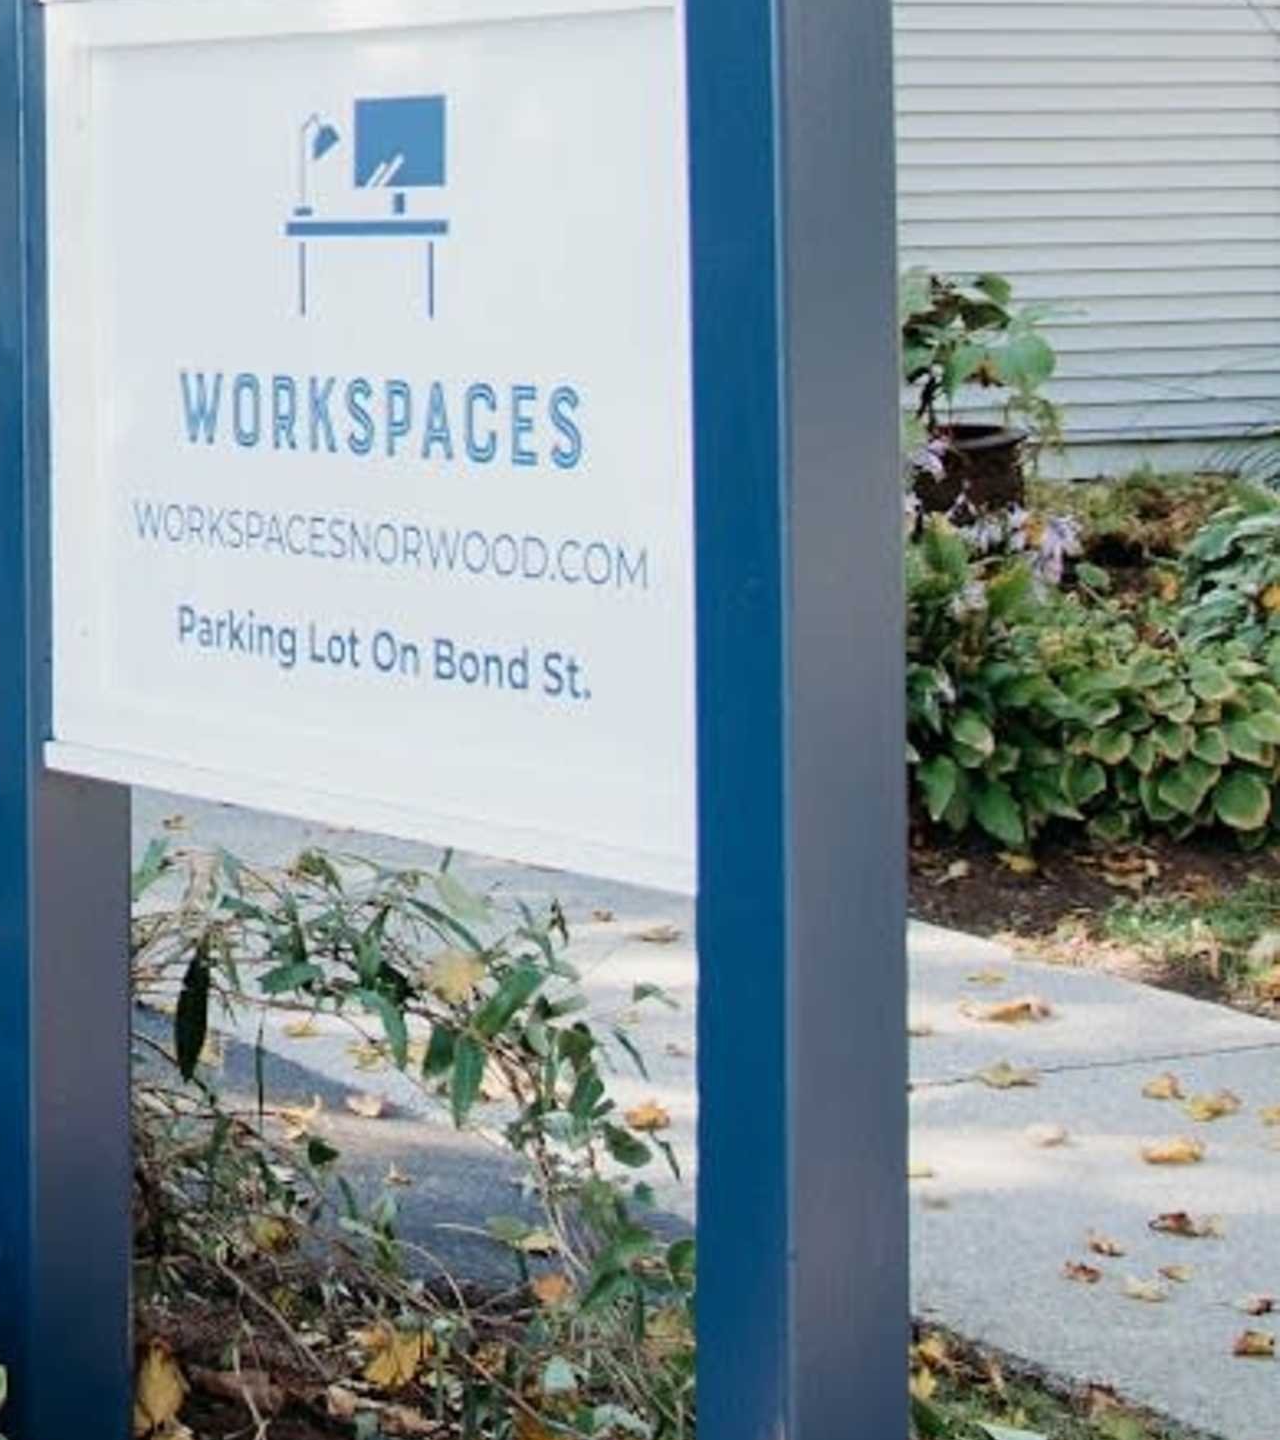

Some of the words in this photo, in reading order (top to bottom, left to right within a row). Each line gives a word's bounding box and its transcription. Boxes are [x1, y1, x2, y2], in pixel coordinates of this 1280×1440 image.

[178, 369, 584, 471] WORKSPACES
[132, 499, 649, 591] WORKSPACESNORWOOD.COM
[177, 603, 298, 671] Parking
[307, 621, 362, 671] Lot
[371, 629, 422, 677] On
[431, 637, 530, 692] Bond
[542, 650, 593, 701] St.
